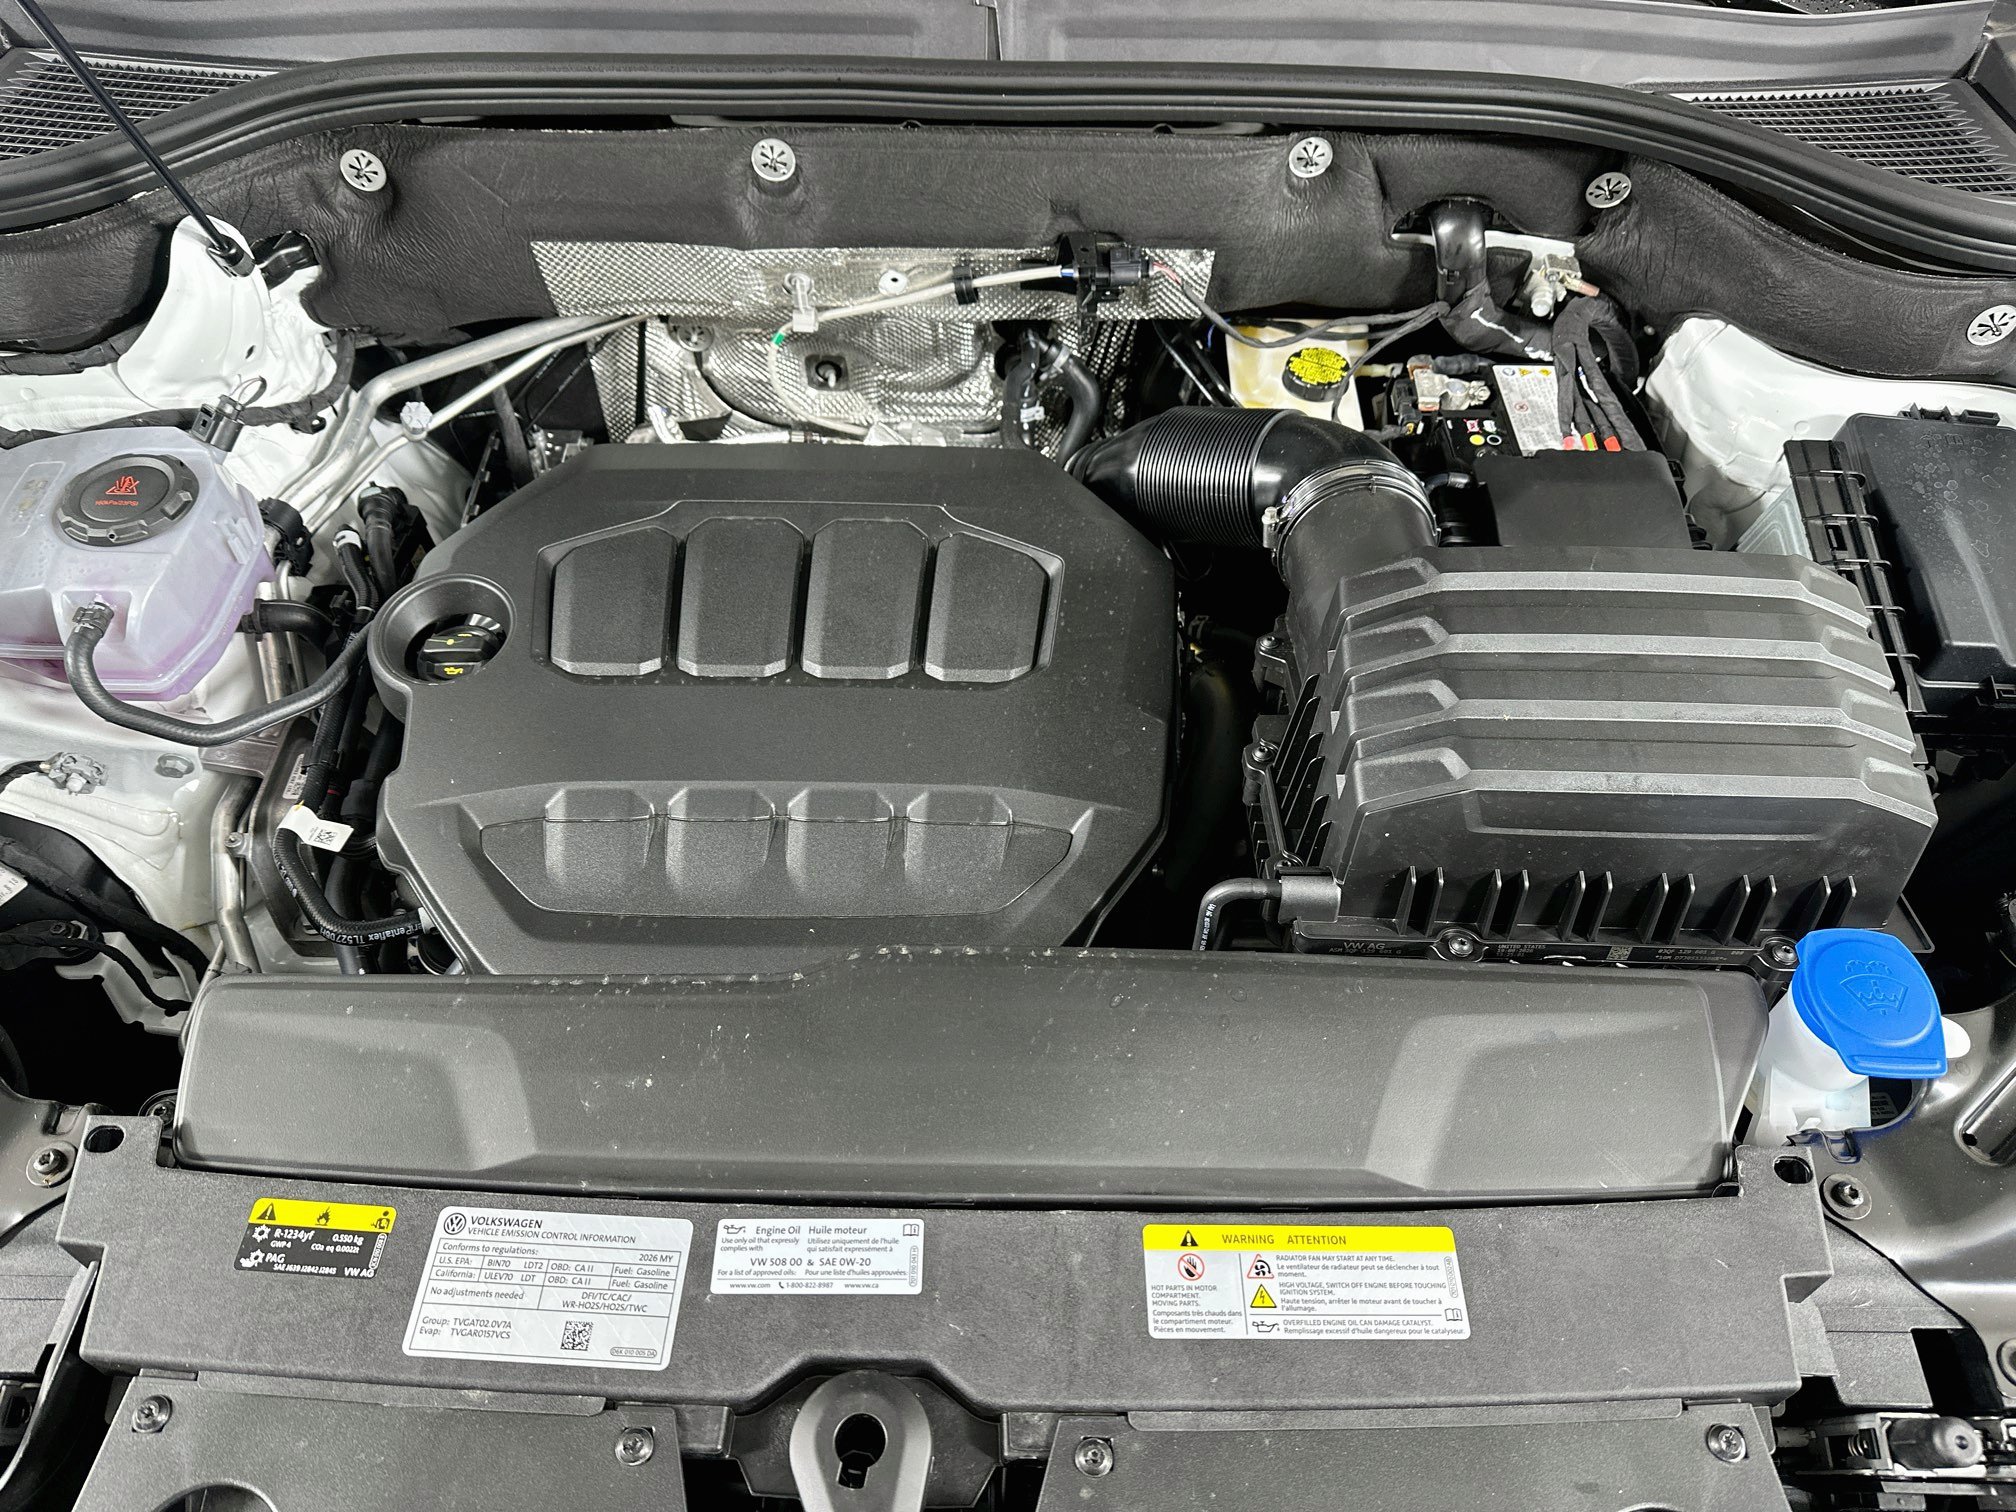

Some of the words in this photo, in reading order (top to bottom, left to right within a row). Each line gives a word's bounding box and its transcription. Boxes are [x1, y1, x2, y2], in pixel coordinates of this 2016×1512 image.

[1343, 941, 1365, 949] VW
[1367, 942, 1386, 950] AG
[471, 1215, 543, 1229] VOLKSWAGEN
[755, 1225, 786, 1237] Engine
[787, 1225, 801, 1235] Oil
[808, 1225, 832, 1234] Huile
[834, 1226, 867, 1234] moteur
[354, 1234, 364, 1246] kg
[468, 1227, 499, 1236] VEHICLE
[501, 1228, 540, 1238] EMISSION
[541, 1231, 578, 1241] CONTROL
[579, 1233, 636, 1244] INFORMATION
[733, 1236, 747, 1245] only
[747, 1236, 756, 1244] oil
[756, 1236, 770, 1244] that
[770, 1236, 800, 1245] expressly
[1221, 1234, 1274, 1244] WARNING
[1287, 1234, 1346, 1245] ATTENTION
[831, 1238, 870, 1246] uniquement
[880, 1237, 899, 1245] l'huile
[442, 1242, 480, 1252] Conforms
[481, 1244, 490, 1252] to
[493, 1246, 539, 1256] regulations:
[720, 1244, 748, 1253] complies
[806, 1245, 817, 1253] qui
[265, 1252, 285, 1263] PAG
[438, 1256, 453, 1264] U.S.
[454, 1256, 472, 1265] EPA:
[638, 1253, 658, 1262] 2026
[659, 1254, 674, 1262] MY
[750, 1257, 768, 1266] VW
[769, 1257, 787, 1266] 508
[789, 1257, 802, 1266] 00
[806, 1258, 814, 1266] &
[819, 1257, 837, 1266] SAE
[839, 1257, 871, 1266] 0W-20
[487, 1258, 511, 1268] BIN70
[523, 1261, 543, 1270] LDT2
[550, 1262, 571, 1271] OBD:
[574, 1263, 586, 1272] CA
[587, 1264, 594, 1273] II
[344, 1267, 359, 1277] VW
[360, 1268, 375, 1278] AG
[435, 1268, 476, 1279] California:
[484, 1271, 514, 1281] ULEV70
[520, 1273, 536, 1282] LDT
[614, 1266, 634, 1276] Fuel:
[636, 1267, 670, 1277] Gasoline
[717, 1268, 728, 1276] For
[733, 1268, 744, 1276] list
[744, 1268, 752, 1276] of
[752, 1268, 783, 1277] approved
[783, 1268, 796, 1276] oils:
[804, 1268, 819, 1276] Pour
[832, 1268, 846, 1276] liste
[846, 1268, 870, 1276] d'huiles
[547, 1275, 568, 1284] OBD:
[571, 1276, 583, 1285] CA
[584, 1277, 591, 1285] II
[611, 1279, 631, 1289] Fuel:
[633, 1280, 668, 1290] Gasoline
[1278, 1281, 1294, 1289] HIGH
[1325, 1281, 1350, 1289] SWITCH
[1350, 1281, 1363, 1289] OFF
[430, 1286, 442, 1295] No
[442, 1287, 493, 1298] adjustments
[494, 1290, 525, 1300] needed
[581, 1291, 632, 1302] DFI/TC/CAC/
[1151, 1291, 1200, 1299] COMPARTMENT.
[1279, 1288, 1308, 1296] IGNITION
[1308, 1288, 1335, 1296] SYSTEM.
[1178, 1299, 1200, 1307] PARTS.
[1301, 1297, 1327, 1305] tension,
[1328, 1297, 1350, 1305] arrêter
[1437, 1297, 1442, 1305] à
[562, 1300, 648, 1313] WR-HO2S/HO2S/TWC
[1281, 1304, 1317, 1313] l'allumage.
[1152, 1309, 1191, 1317] Composants
[1191, 1309, 1203, 1317] très
[1204, 1309, 1227, 1317] chauds
[1227, 1309, 1242, 1317] dans
[422, 1316, 450, 1327] Group:
[419, 1325, 441, 1337] Evap:
[1153, 1325, 1174, 1333] Pièces
[1283, 1326, 1324, 1336] Remplissage
[1373, 1327, 1407, 1336] dangereux
[1431, 1327, 1466, 1336] catalyseur.
